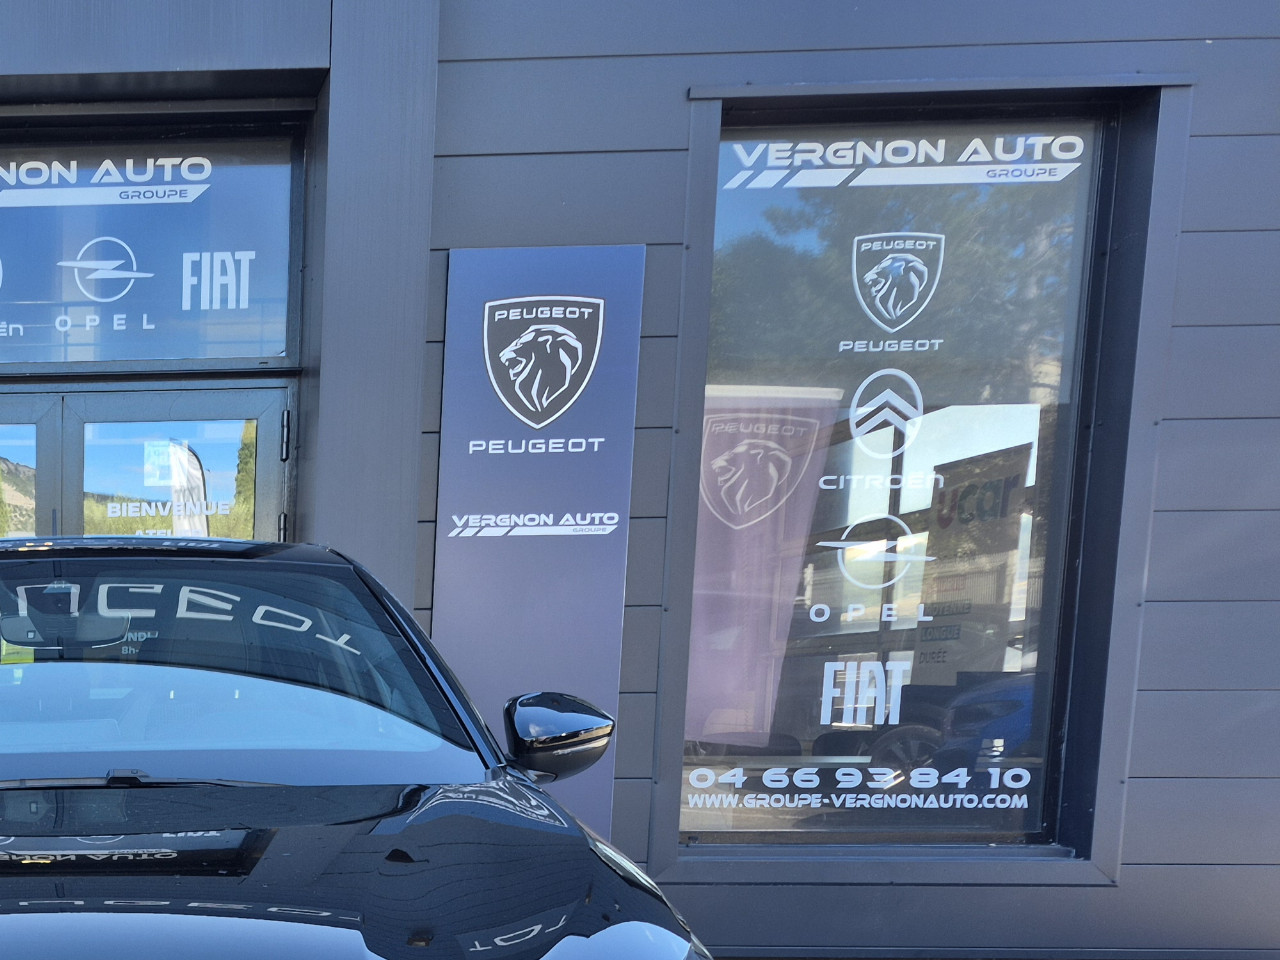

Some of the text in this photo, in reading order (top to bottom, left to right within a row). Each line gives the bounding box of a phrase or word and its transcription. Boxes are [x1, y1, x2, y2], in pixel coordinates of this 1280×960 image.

[732, 135, 1085, 167] VERGNON AUTO
[89, 156, 213, 185] AUTO
[985, 167, 1059, 179] GROUPE
[118, 188, 190, 201] GROUPE
[859, 239, 937, 252] PEUGEOT
[181, 250, 257, 311] FIAT
[494, 305, 594, 321] PEUGEOT
[54, 313, 156, 332] OPEL
[837, 338, 944, 353] PEUGEOT
[710, 421, 809, 437] PEUGEOT
[468, 437, 606, 455] PEUGEOT
[107, 500, 232, 518] BIENVENUE
[451, 511, 620, 528] VERGNON AUTO
[809, 603, 933, 623] OPEL
[921, 626, 961, 641] LONGUE
[919, 648, 948, 665] DURÉE
[819, 661, 911, 726] FIAT
[688, 766, 1031, 789] 04 66 93 84 10
[687, 793, 1029, 809] WWW.GROUPE-VERGNONAUTO.COM
